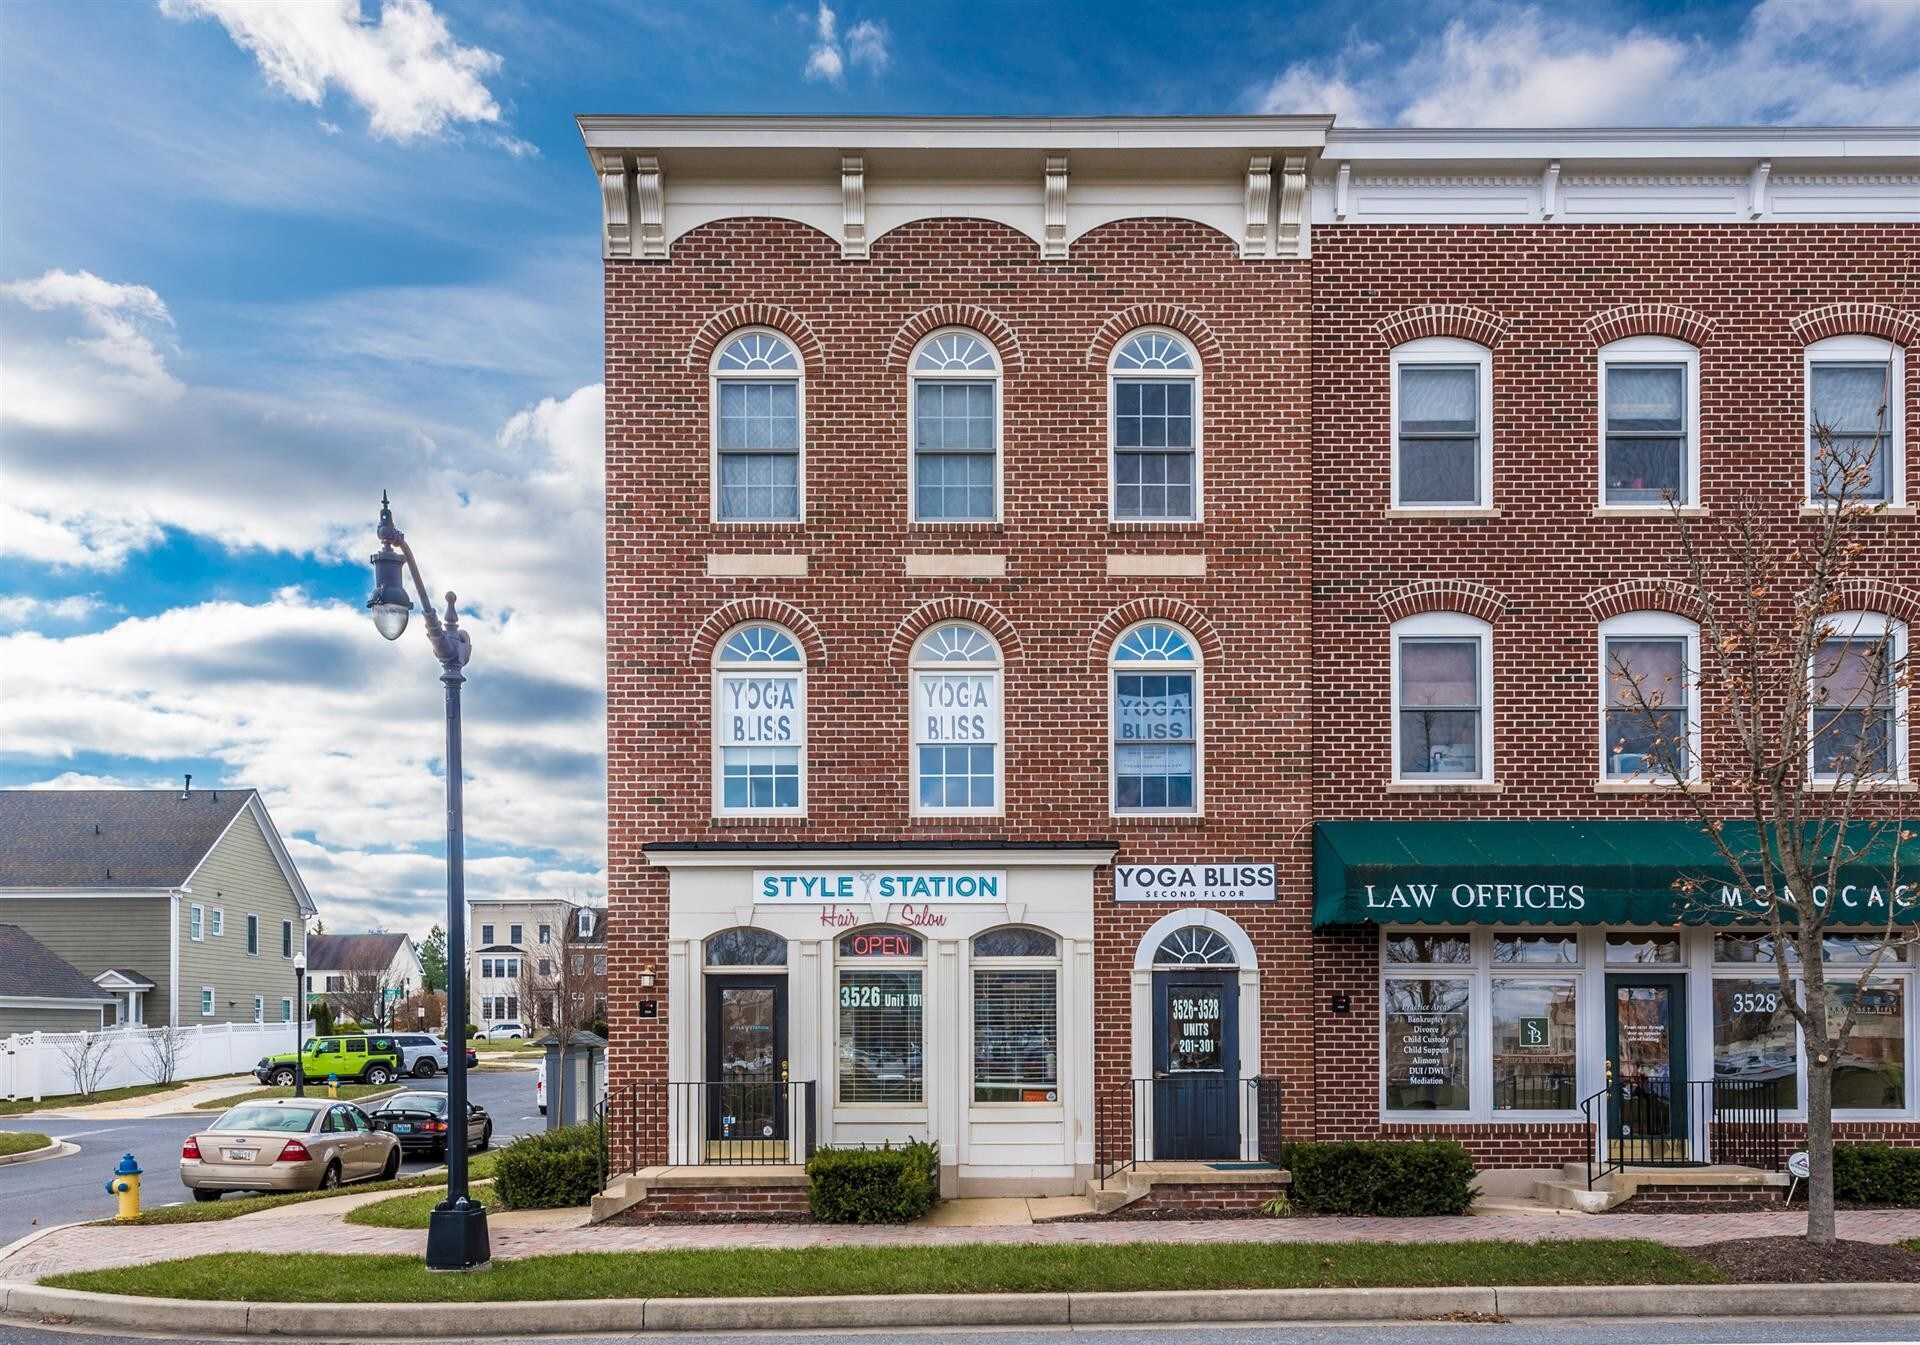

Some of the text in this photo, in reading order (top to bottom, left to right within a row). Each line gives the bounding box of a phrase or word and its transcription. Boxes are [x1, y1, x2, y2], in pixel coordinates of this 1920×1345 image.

[729, 682, 794, 709] YOGA
[924, 682, 988, 708] YOGA
[1119, 699, 1186, 716] YOGA
[733, 715, 791, 741] BLISS
[927, 715, 985, 740] BLISS
[1122, 722, 1183, 739] BLISS
[763, 876, 997, 897] STYLE STATION
[1117, 867, 1274, 887] YOGA BLISS
[1145, 890, 1245, 898] SECOND FLOOR
[1364, 883, 1585, 910] LAW OFFICES
[820, 903, 947, 927] Hair Salon
[854, 936, 909, 956] OPEN
[840, 986, 922, 1007] 3526 Unit 101
[1733, 993, 1777, 1013] 3528
[1172, 999, 1219, 1020] 3526-3528
[1183, 1022, 1209, 1036] UNITS
[1407, 1016, 1445, 1025] Bankruptcy
[1179, 1039, 1214, 1053] 201-301
[1403, 1046, 1449, 1055] Child Support
[1422, 1036, 1449, 1045] Custody
[1409, 1067, 1423, 1075] DUI
[1428, 1067, 1444, 1075] DWI
[1412, 1057, 1441, 1066] Alimony
[1410, 1077, 1443, 1085] Mediation
